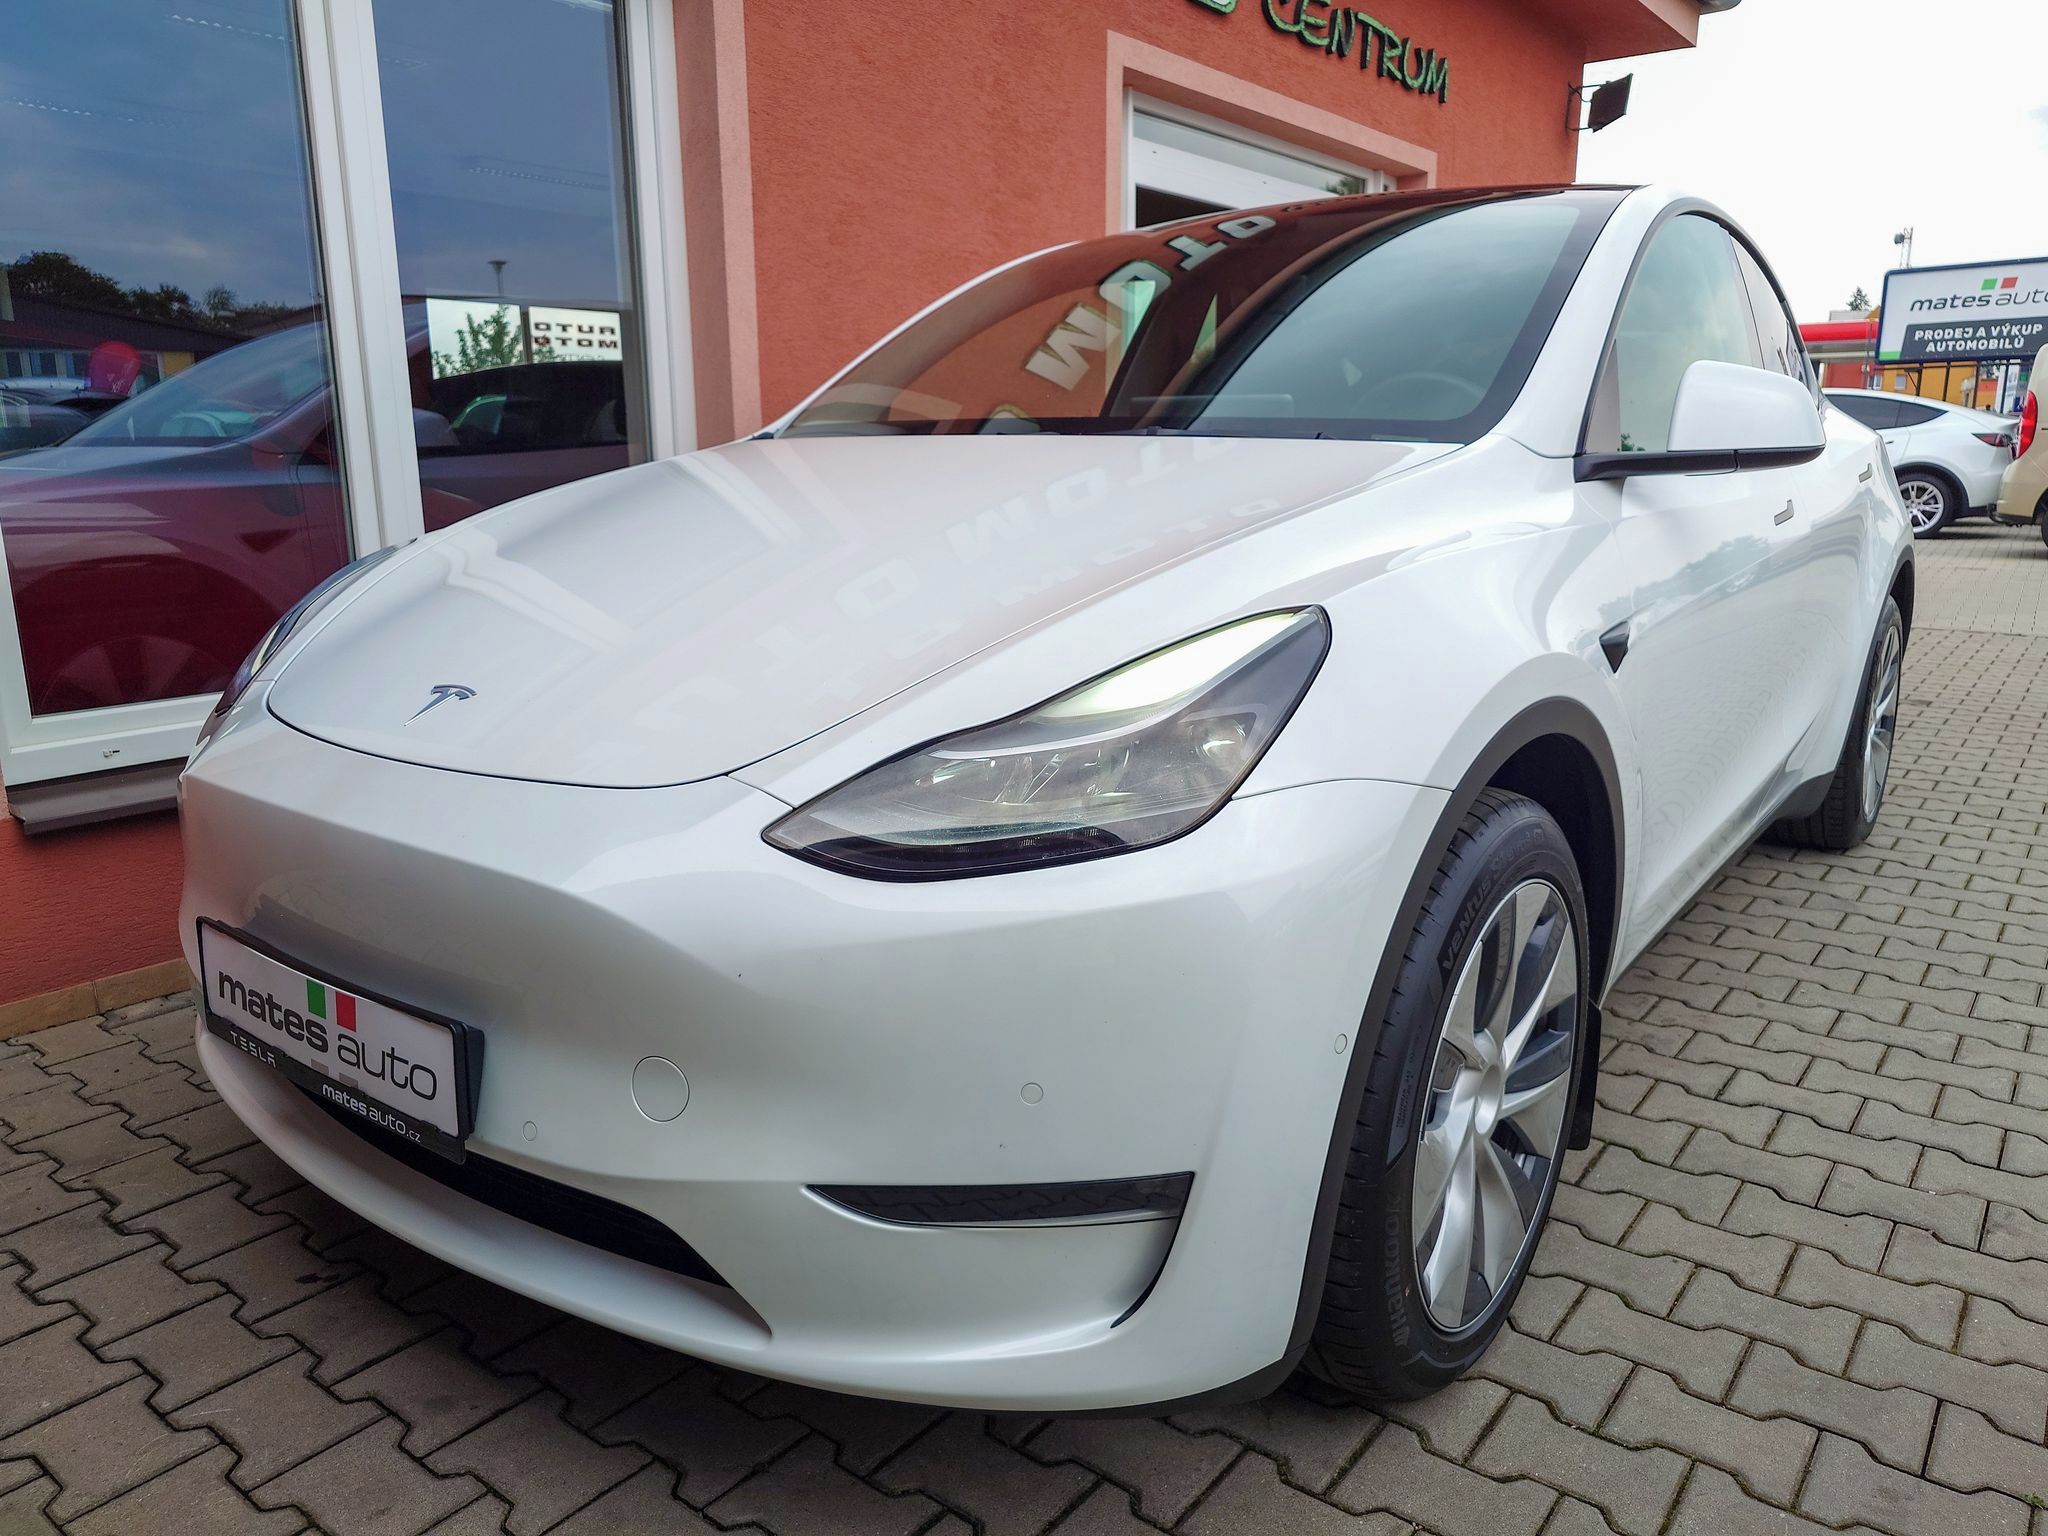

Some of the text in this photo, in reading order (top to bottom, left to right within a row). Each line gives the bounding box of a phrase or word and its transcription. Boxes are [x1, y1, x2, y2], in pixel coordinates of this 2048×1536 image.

[1261, 0, 1448, 103] CENTRUM
[1914, 322, 2043, 341] PRODEJ A VÝKUP
[1925, 335, 2025, 353] AUTOMOBILŮ
[230, 1030, 276, 1069] TESLA
